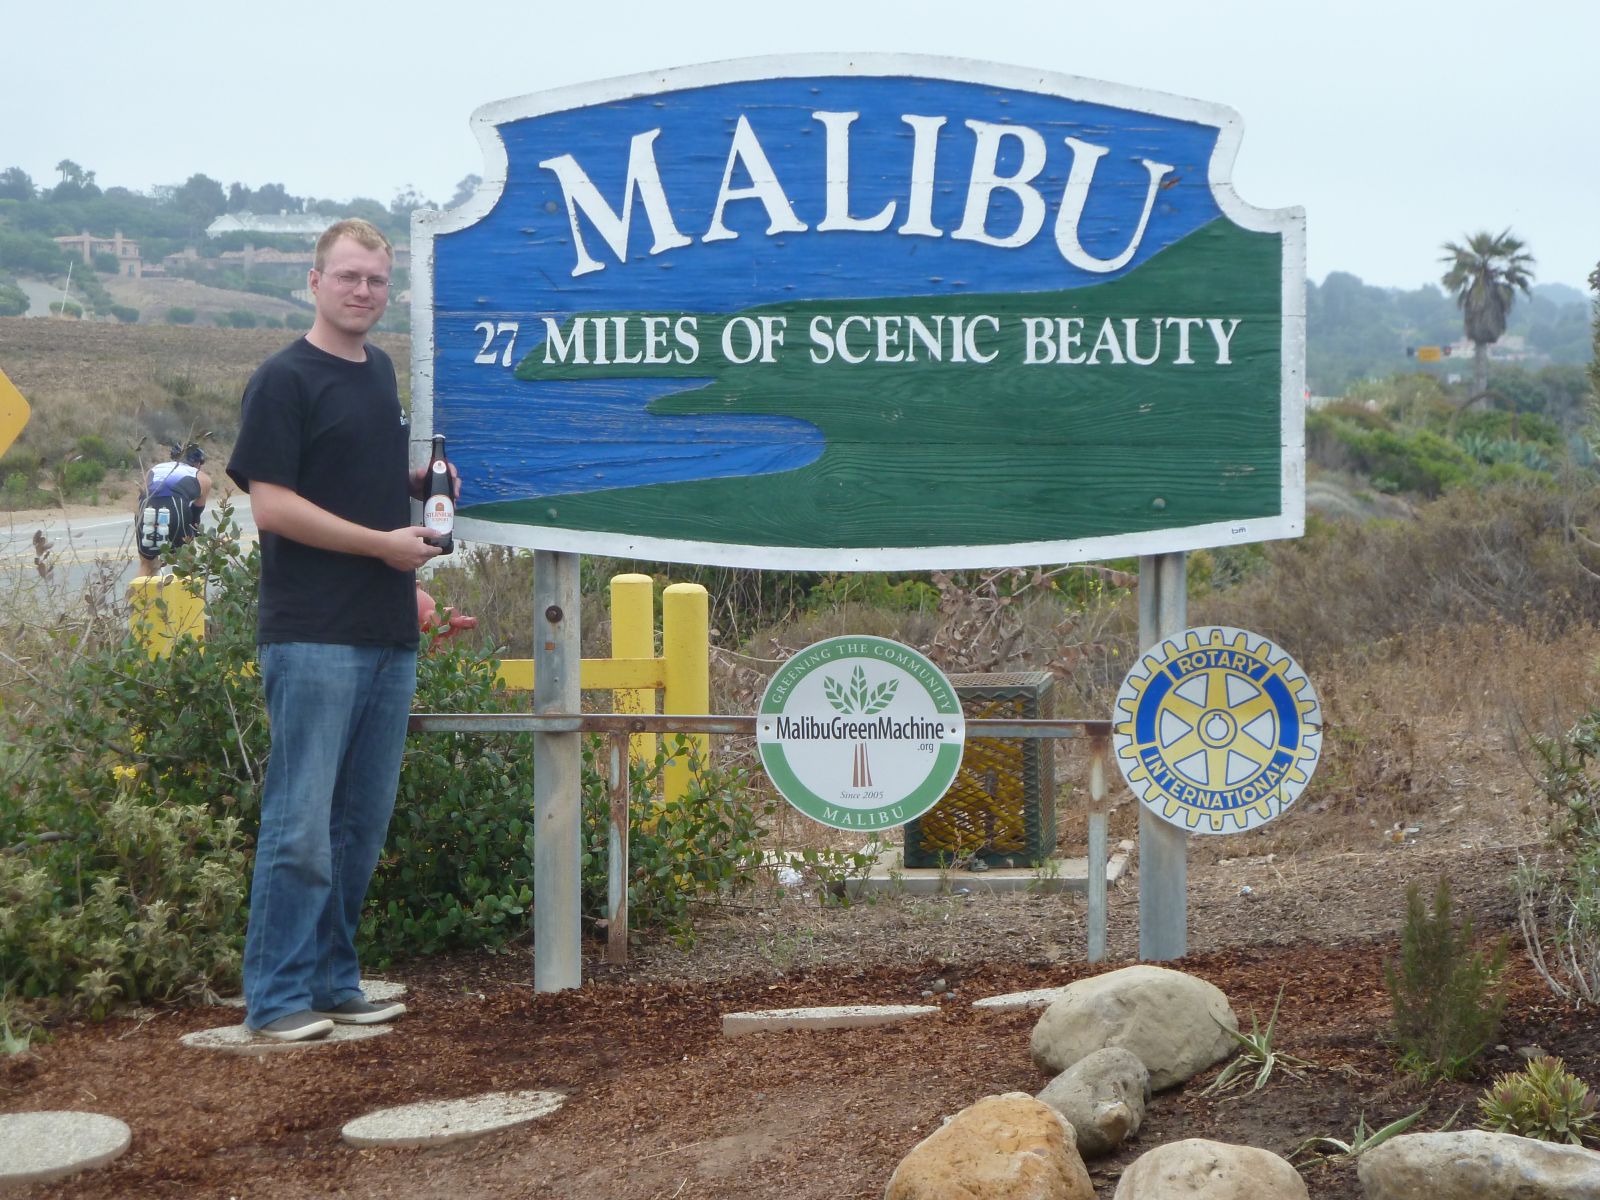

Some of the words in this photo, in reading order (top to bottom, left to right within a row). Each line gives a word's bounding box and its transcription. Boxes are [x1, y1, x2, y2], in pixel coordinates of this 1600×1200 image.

[539, 111, 1174, 277] MALIBU
[473, 321, 519, 367] 27
[542, 316, 699, 364] MILES
[721, 316, 787, 364] OF
[809, 315, 1000, 365] SCENIC
[1022, 317, 1242, 365] BEAUTY
[1176, 651, 1262, 674] ROTARY
[772, 650, 832, 704] GREENING
[836, 643, 869, 655] THE
[874, 645, 951, 709] COMMUNITY
[776, 716, 944, 740] MalibuGreenMachine
[917, 742, 934, 753] .org
[1144, 753, 1289, 809] INTERNATIONAL
[840, 791, 861, 799] Since
[862, 791, 884, 799] 2005
[822, 806, 905, 825] MALIBU
